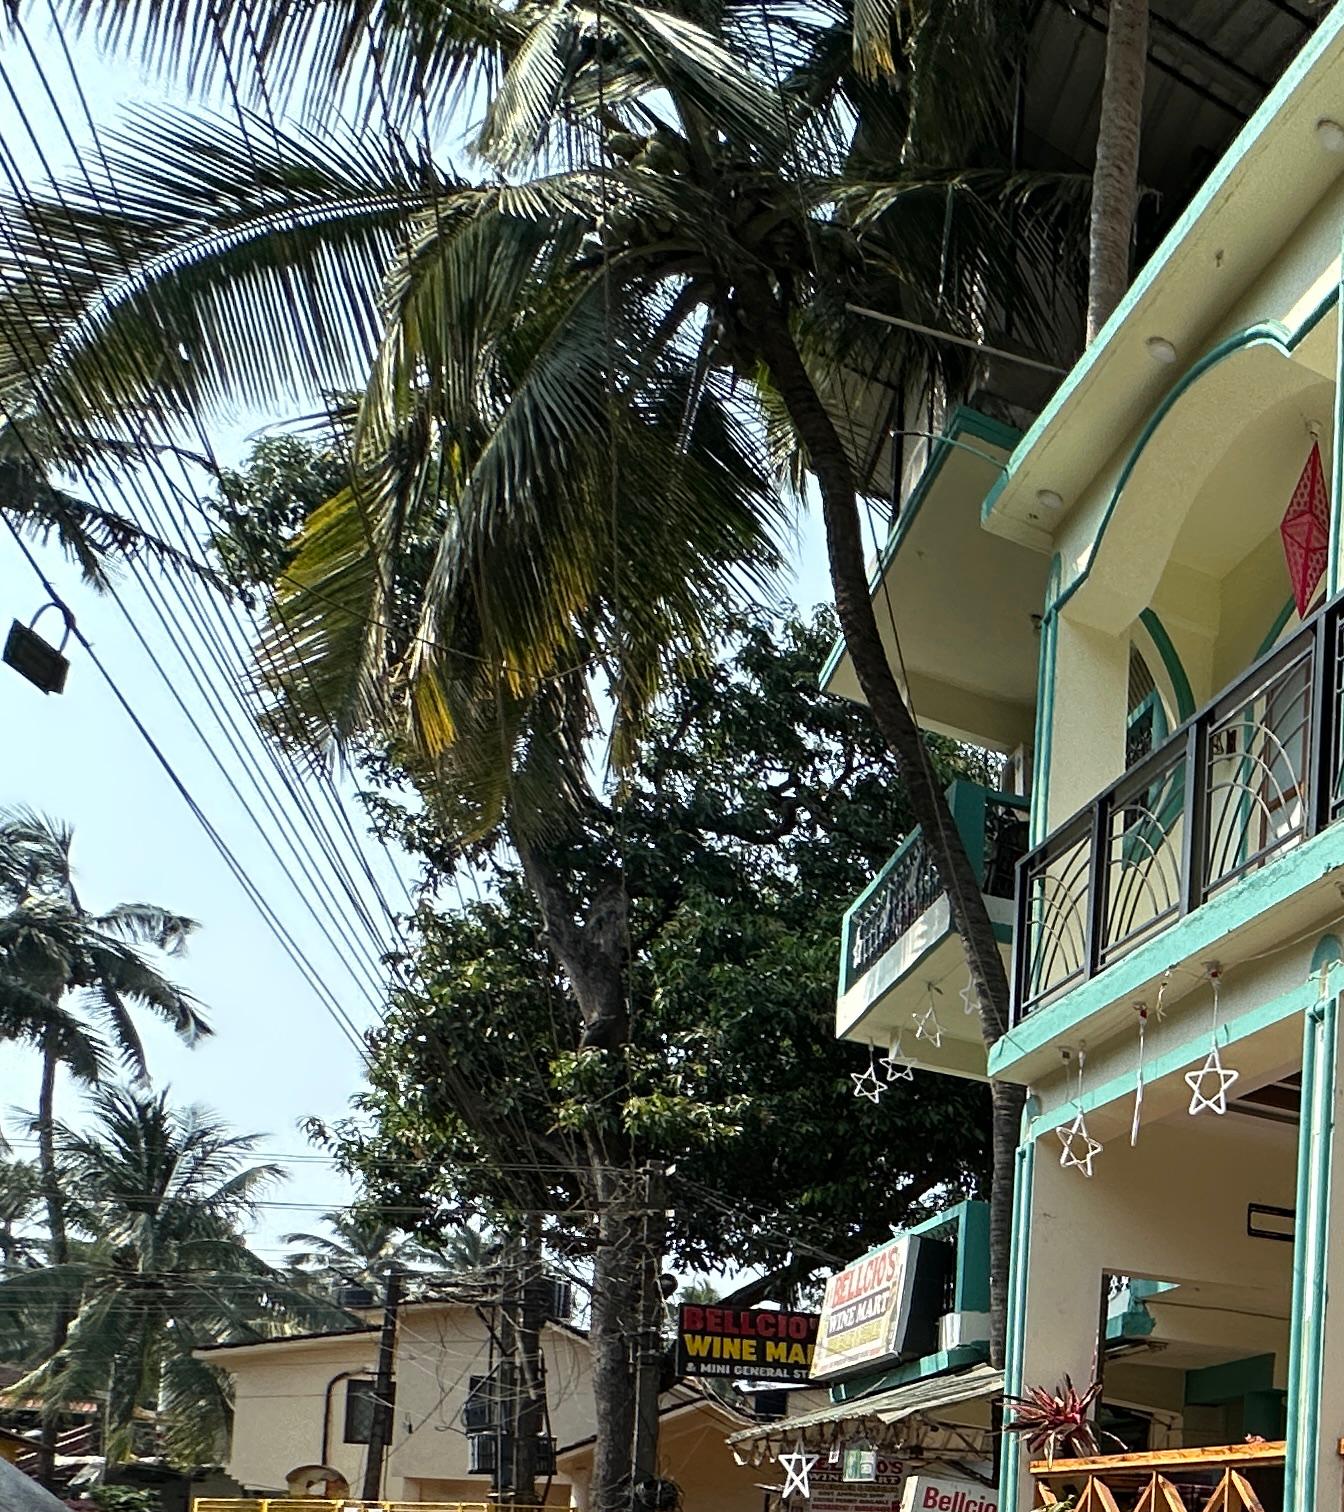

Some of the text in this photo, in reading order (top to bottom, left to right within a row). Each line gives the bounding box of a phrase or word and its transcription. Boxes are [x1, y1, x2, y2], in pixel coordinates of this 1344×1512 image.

[683, 1306, 817, 1339] BELLCIO'
[829, 1292, 889, 1333] WINE MART
[684, 1333, 757, 1361] WINE
[686, 1362, 808, 1379] & MINI GENERAL ST
